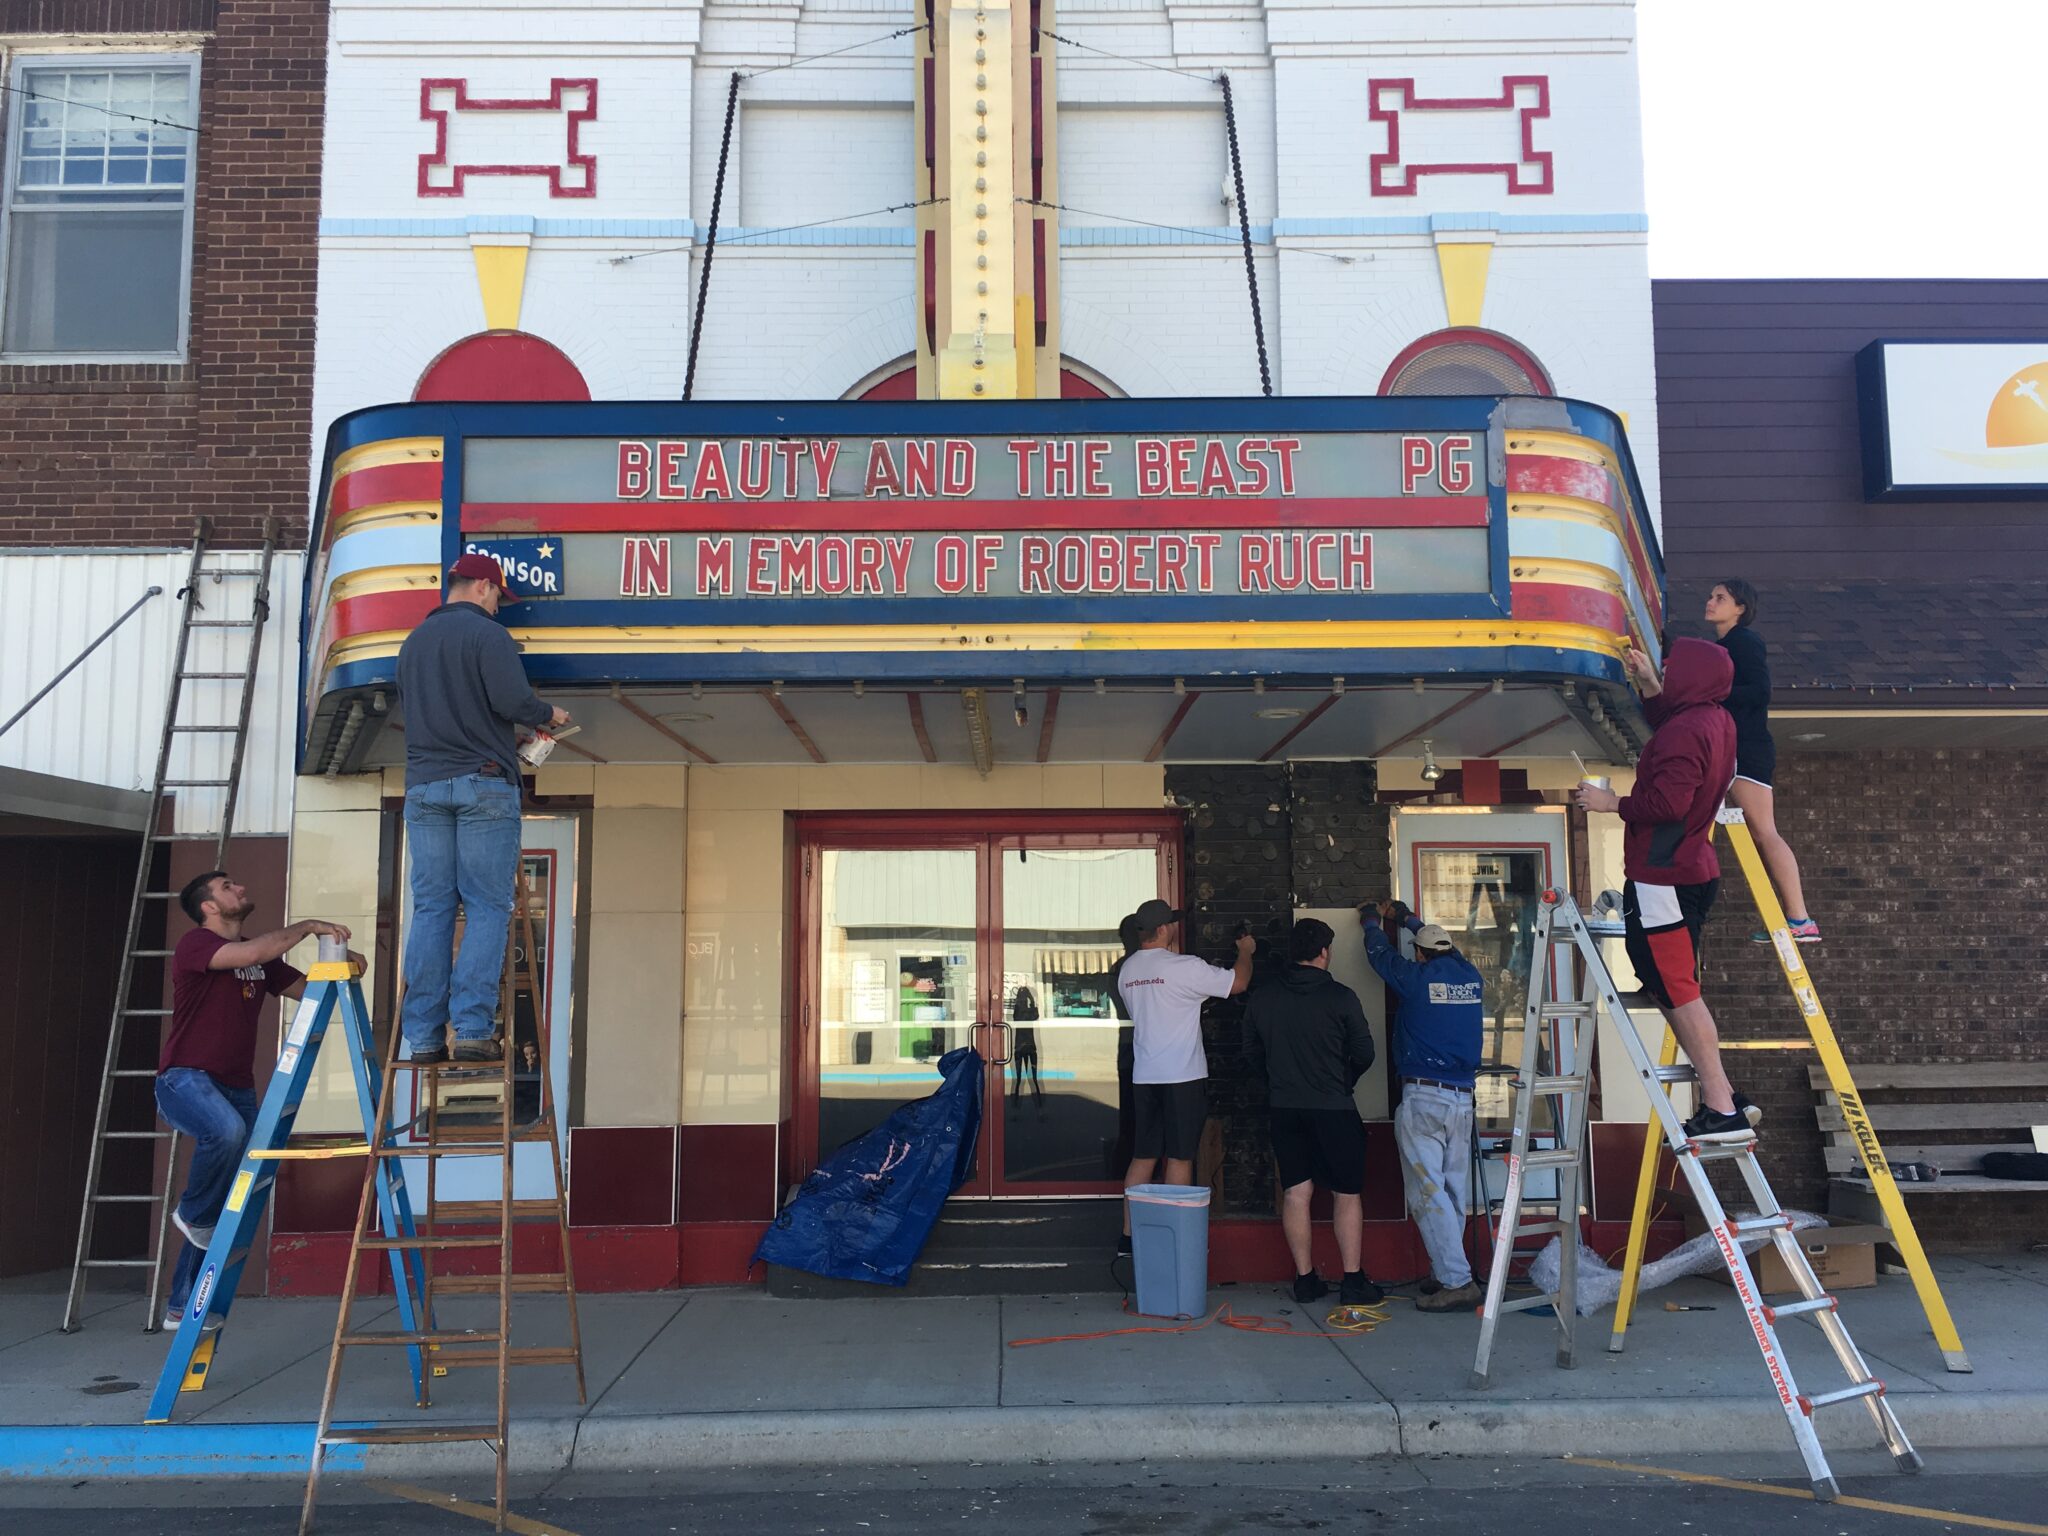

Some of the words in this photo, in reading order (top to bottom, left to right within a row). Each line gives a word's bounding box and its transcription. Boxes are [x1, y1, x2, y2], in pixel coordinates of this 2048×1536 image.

[616, 440, 840, 500] BEAUTY
[864, 439, 977, 497] AND
[1008, 440, 1112, 497] THE
[1136, 438, 1301, 496] BEAST
[1401, 437, 1473, 494] PG
[620, 538, 671, 597] IN
[696, 537, 914, 596] MEMORY
[935, 536, 1003, 593] OF
[1019, 534, 1222, 594] ROBERT
[1239, 532, 1374, 591] RUCH
[1125, 977, 1165, 988] northern.edu
[197, 1273, 212, 1308] WERNER
[1714, 1226, 1738, 1268] LITTLE
[1733, 1270, 1753, 1304] GIANT
[1747, 1306, 1772, 1353] LADDER
[1767, 1355, 1793, 1405] SYSTEM
